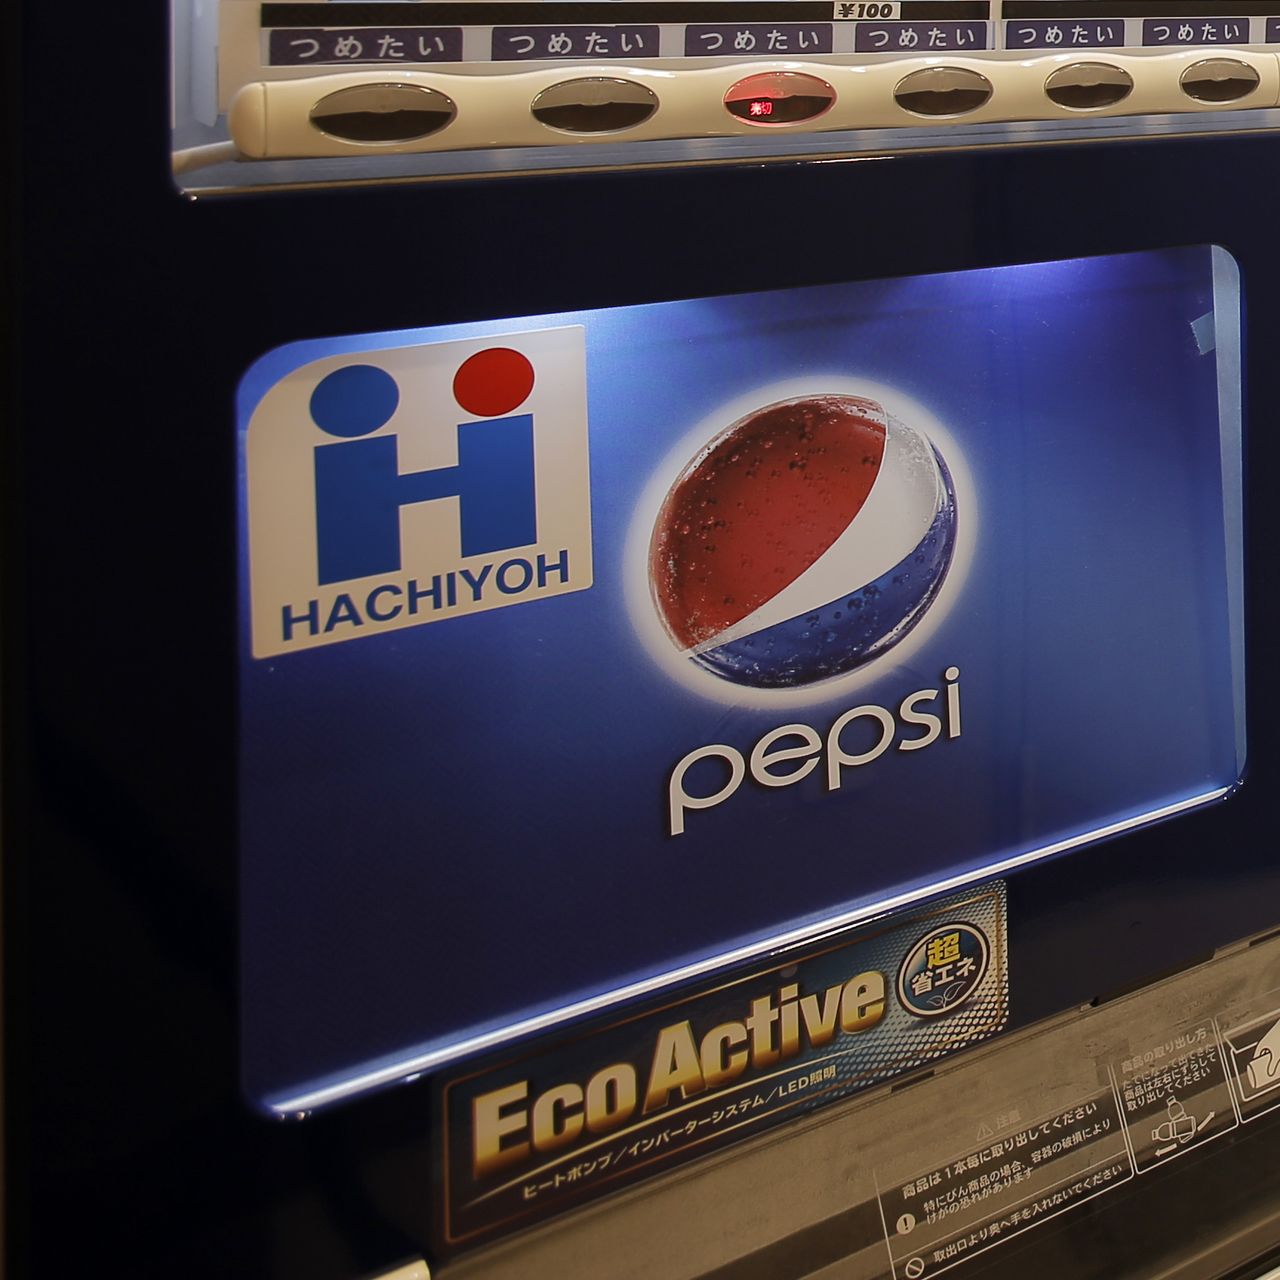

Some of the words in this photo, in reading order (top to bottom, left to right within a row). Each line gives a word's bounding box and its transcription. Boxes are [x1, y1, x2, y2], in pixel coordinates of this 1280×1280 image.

[837, 2, 894, 19] ¥100
[510, 31, 644, 55] つめたい
[700, 30, 820, 51] つめたい
[1017, 23, 1116, 46] つめたい
[1153, 22, 1241, 43] つめたい
[280, 548, 571, 643] HACHIYOH
[668, 665, 965, 838] pepsi
[925, 932, 961, 968] 超
[911, 958, 978, 995] 省エネ
[1120, 1029, 1208, 1074] 商品の取り出し方
[1124, 1053, 1217, 1101] 商品は左右にずらして
[1126, 1067, 1211, 1112] 取り出してください
[926, 1167, 1034, 1225] けがの恐れがあります
[933, 1163, 1123, 1264] 取出口より奥へ手を入れないでください
